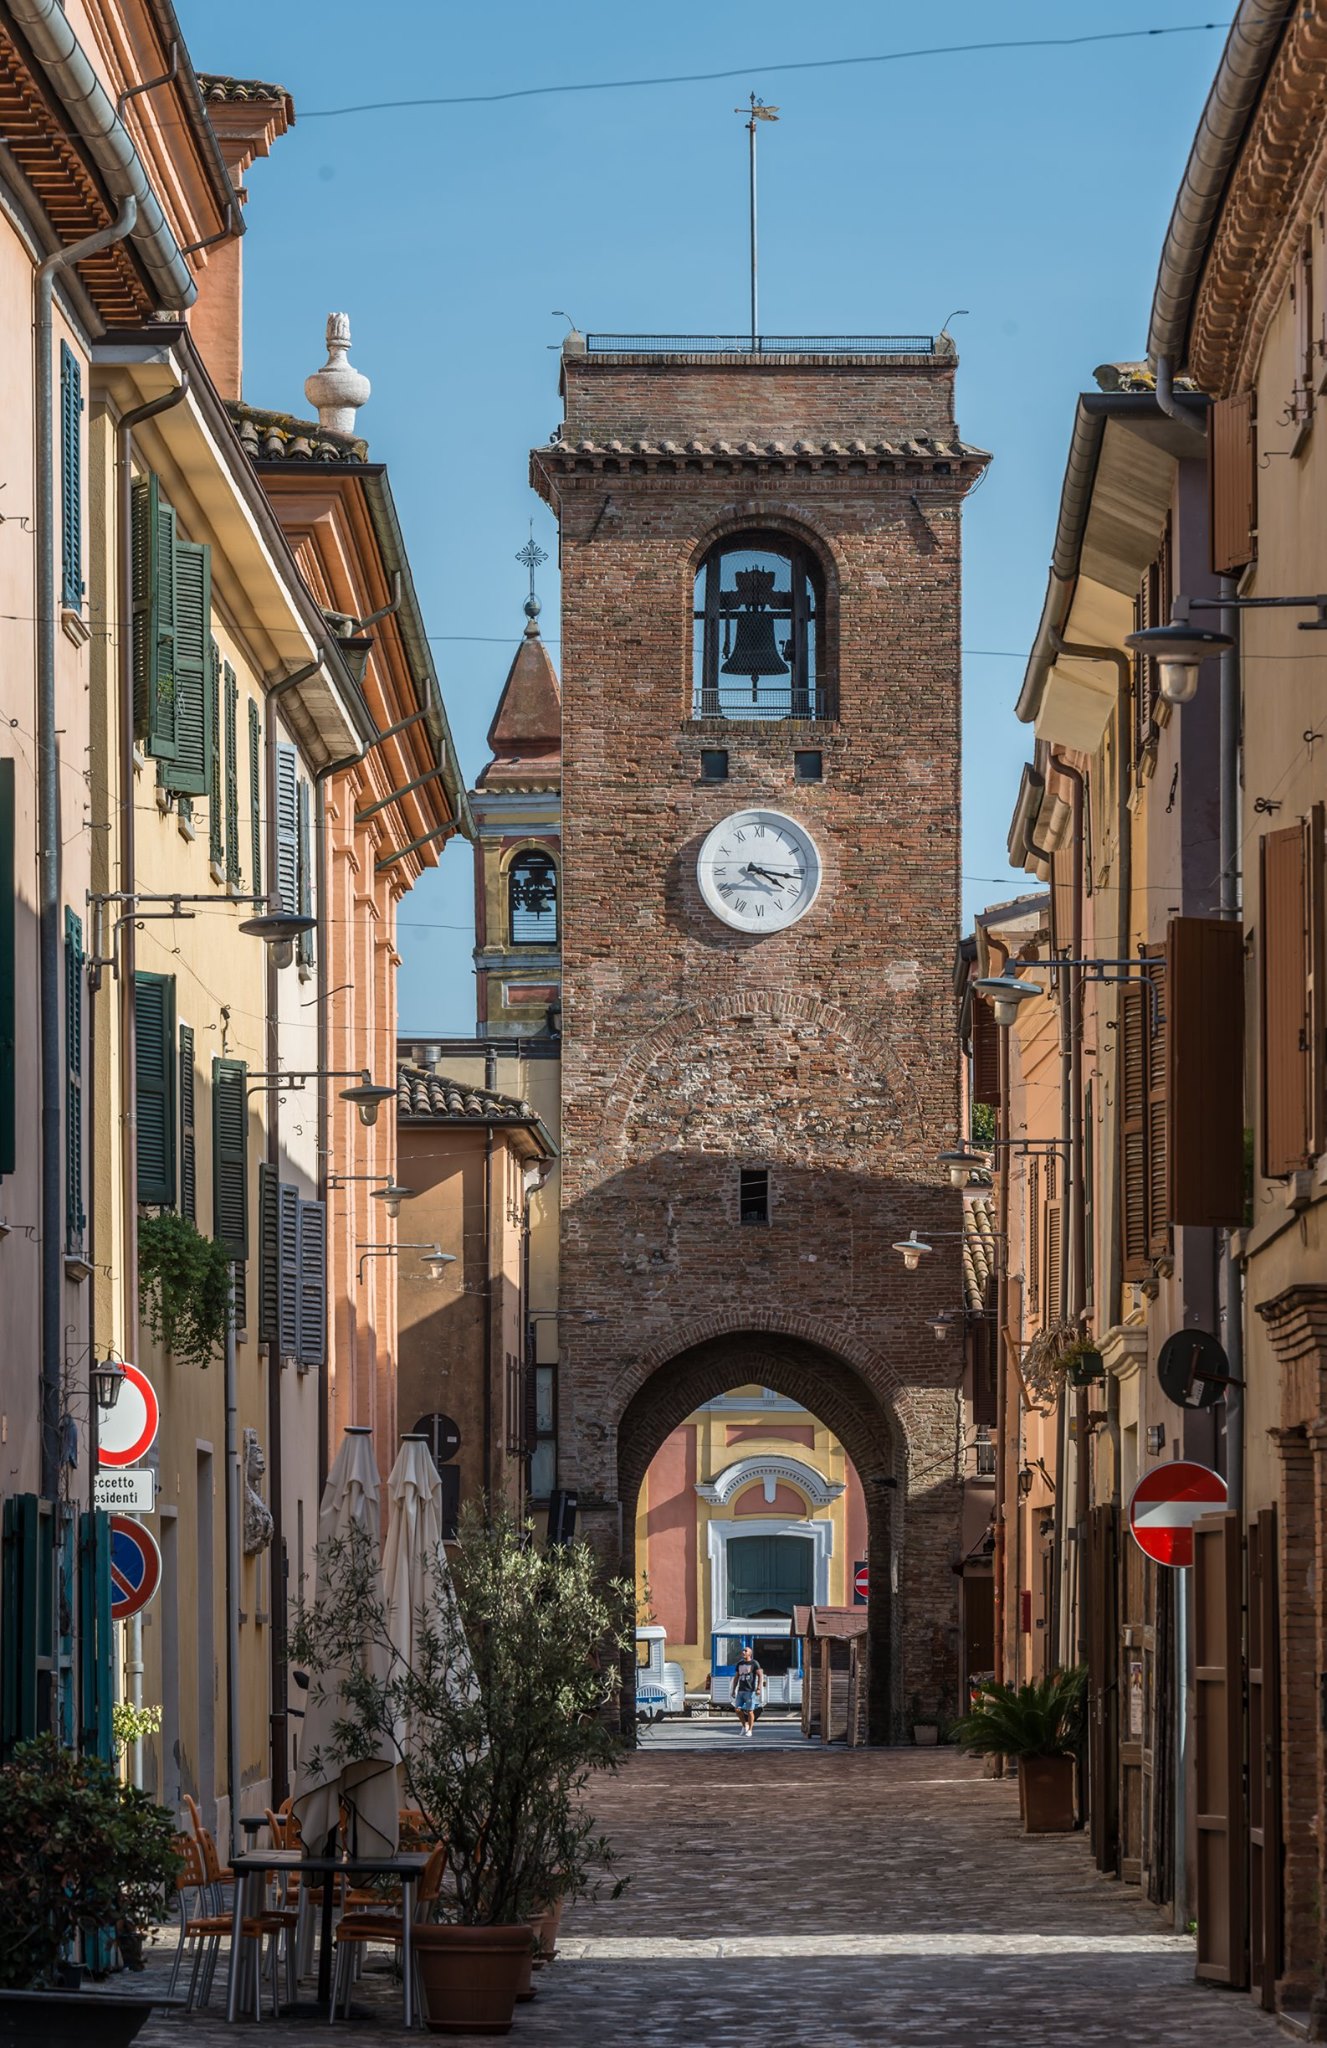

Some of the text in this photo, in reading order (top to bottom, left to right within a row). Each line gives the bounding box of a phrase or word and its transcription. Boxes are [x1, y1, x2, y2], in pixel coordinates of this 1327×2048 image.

[733, 830, 746, 843] XI
[754, 826, 765, 838] XII
[776, 831, 783, 842] I
[719, 846, 731, 857] X
[788, 847, 800, 856] II
[714, 867, 726, 876] IX
[719, 882, 734, 899] VIII
[787, 884, 799, 898] IV
[734, 898, 747, 913] VII
[755, 905, 764, 917] VI
[774, 899, 783, 911] V
[94, 1492, 138, 1503] esidenti
